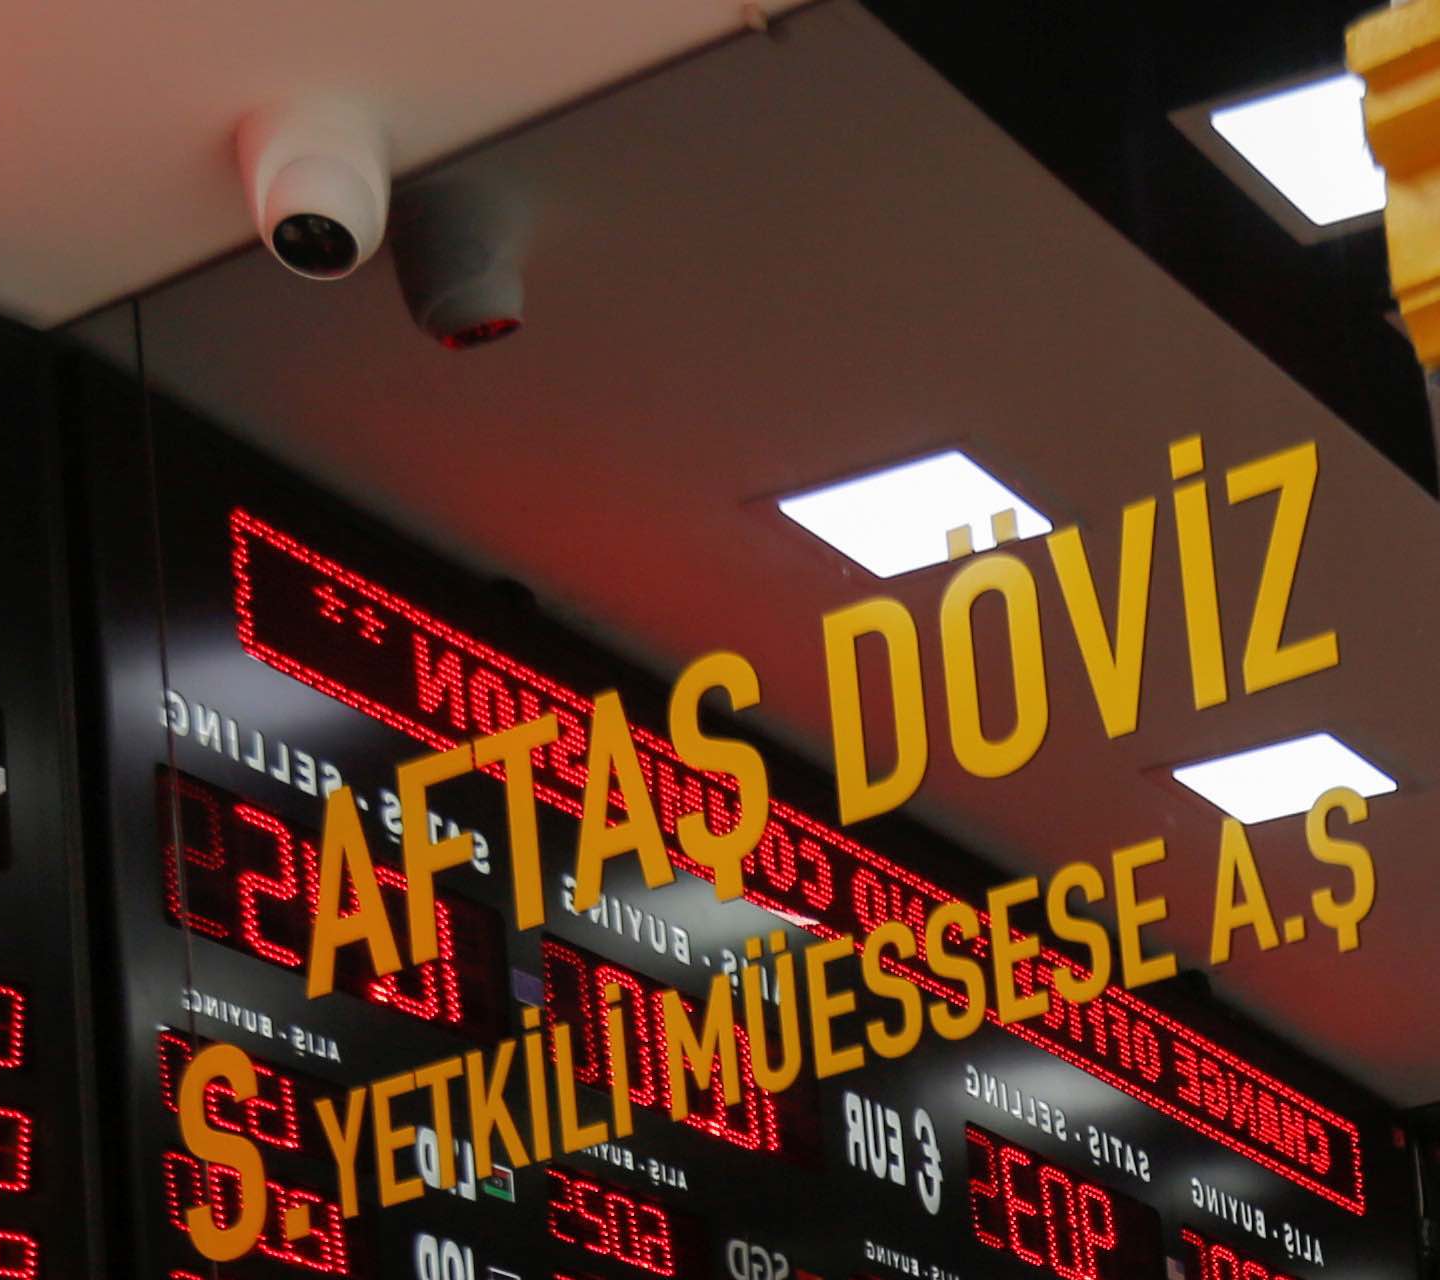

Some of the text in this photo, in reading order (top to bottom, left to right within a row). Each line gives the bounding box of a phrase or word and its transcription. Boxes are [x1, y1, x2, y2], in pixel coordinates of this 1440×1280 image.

[307, 651, 768, 999] AFTAŞ
[822, 434, 1338, 825] DÖVİZ
[317, 983, 634, 1219] YETKİLİ
[662, 837, 1176, 1122] MÜESSESE
